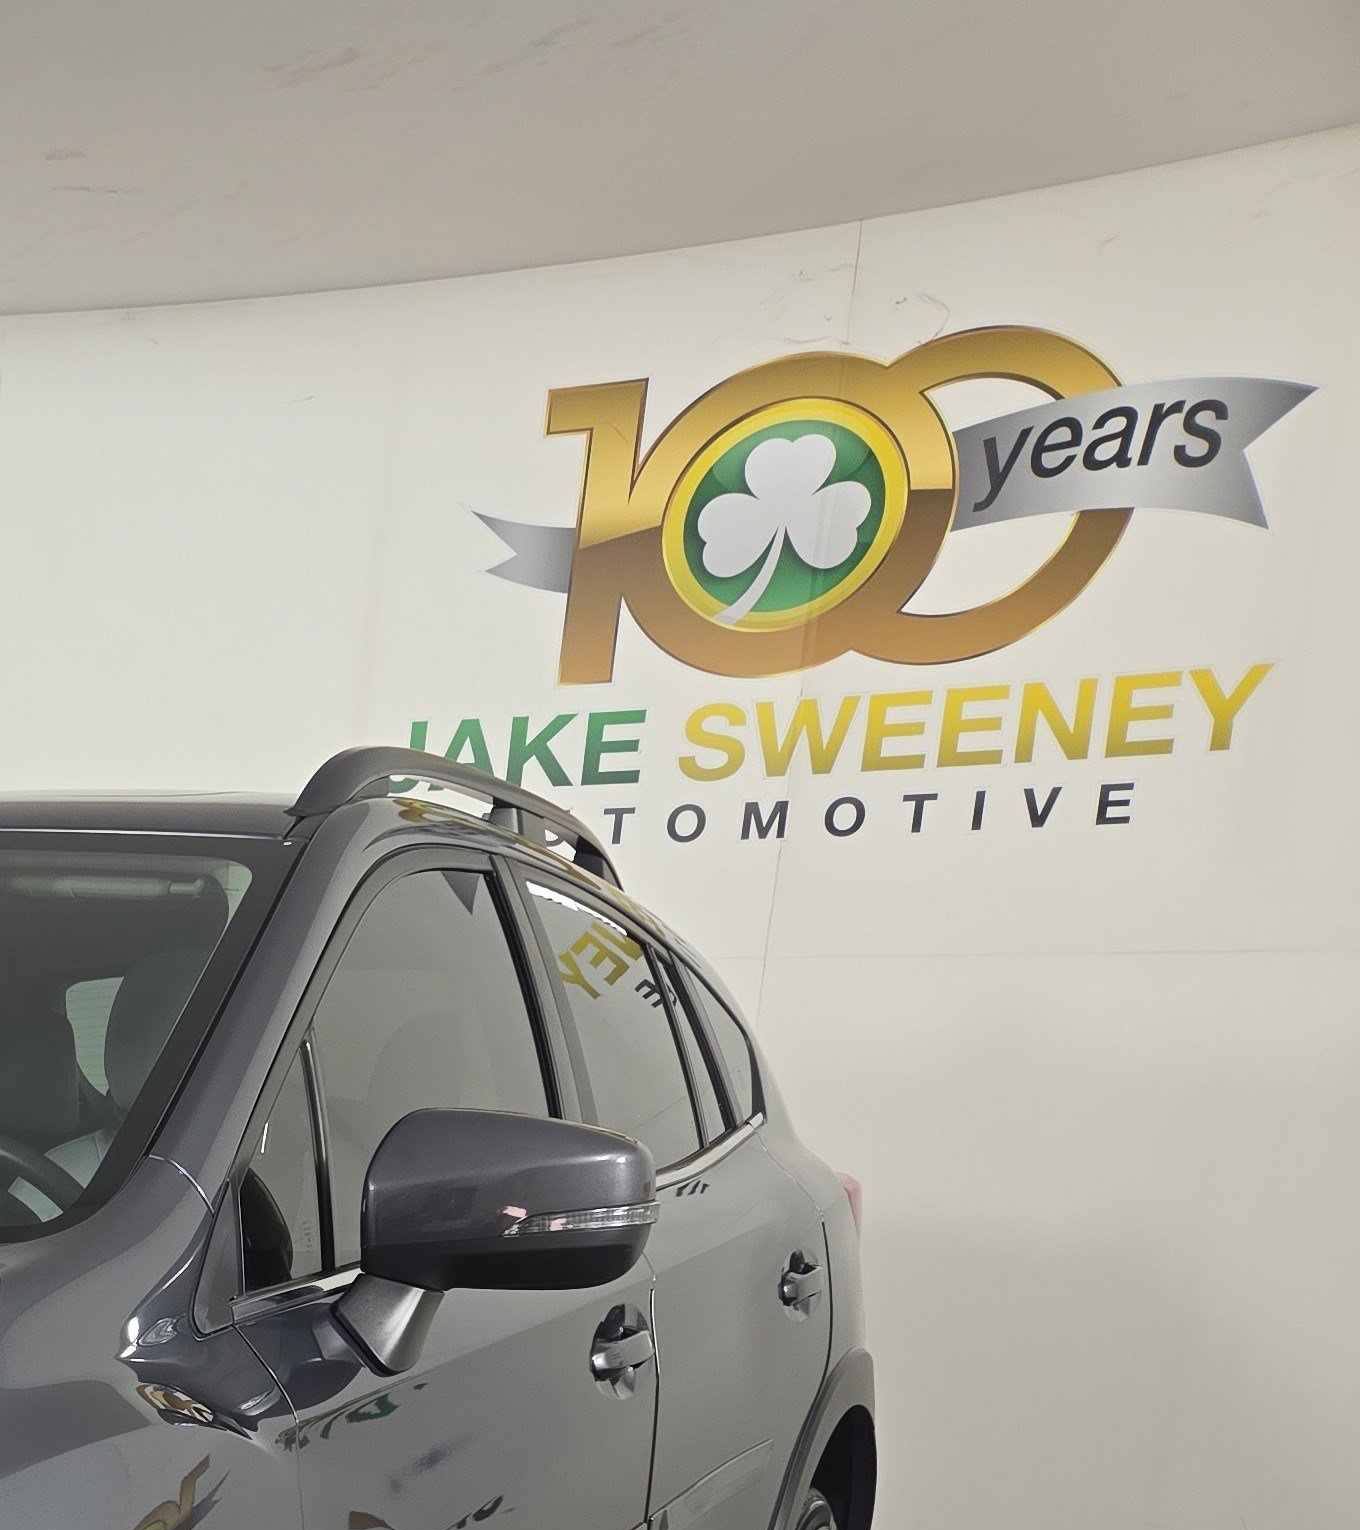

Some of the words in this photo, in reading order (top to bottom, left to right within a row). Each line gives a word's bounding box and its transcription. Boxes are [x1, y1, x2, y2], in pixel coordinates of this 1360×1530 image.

[542, 324, 1136, 686] 100
[971, 391, 1230, 514] years
[677, 660, 1276, 783] SWEENEY
[482, 781, 1137, 848] TOMOTIVE
